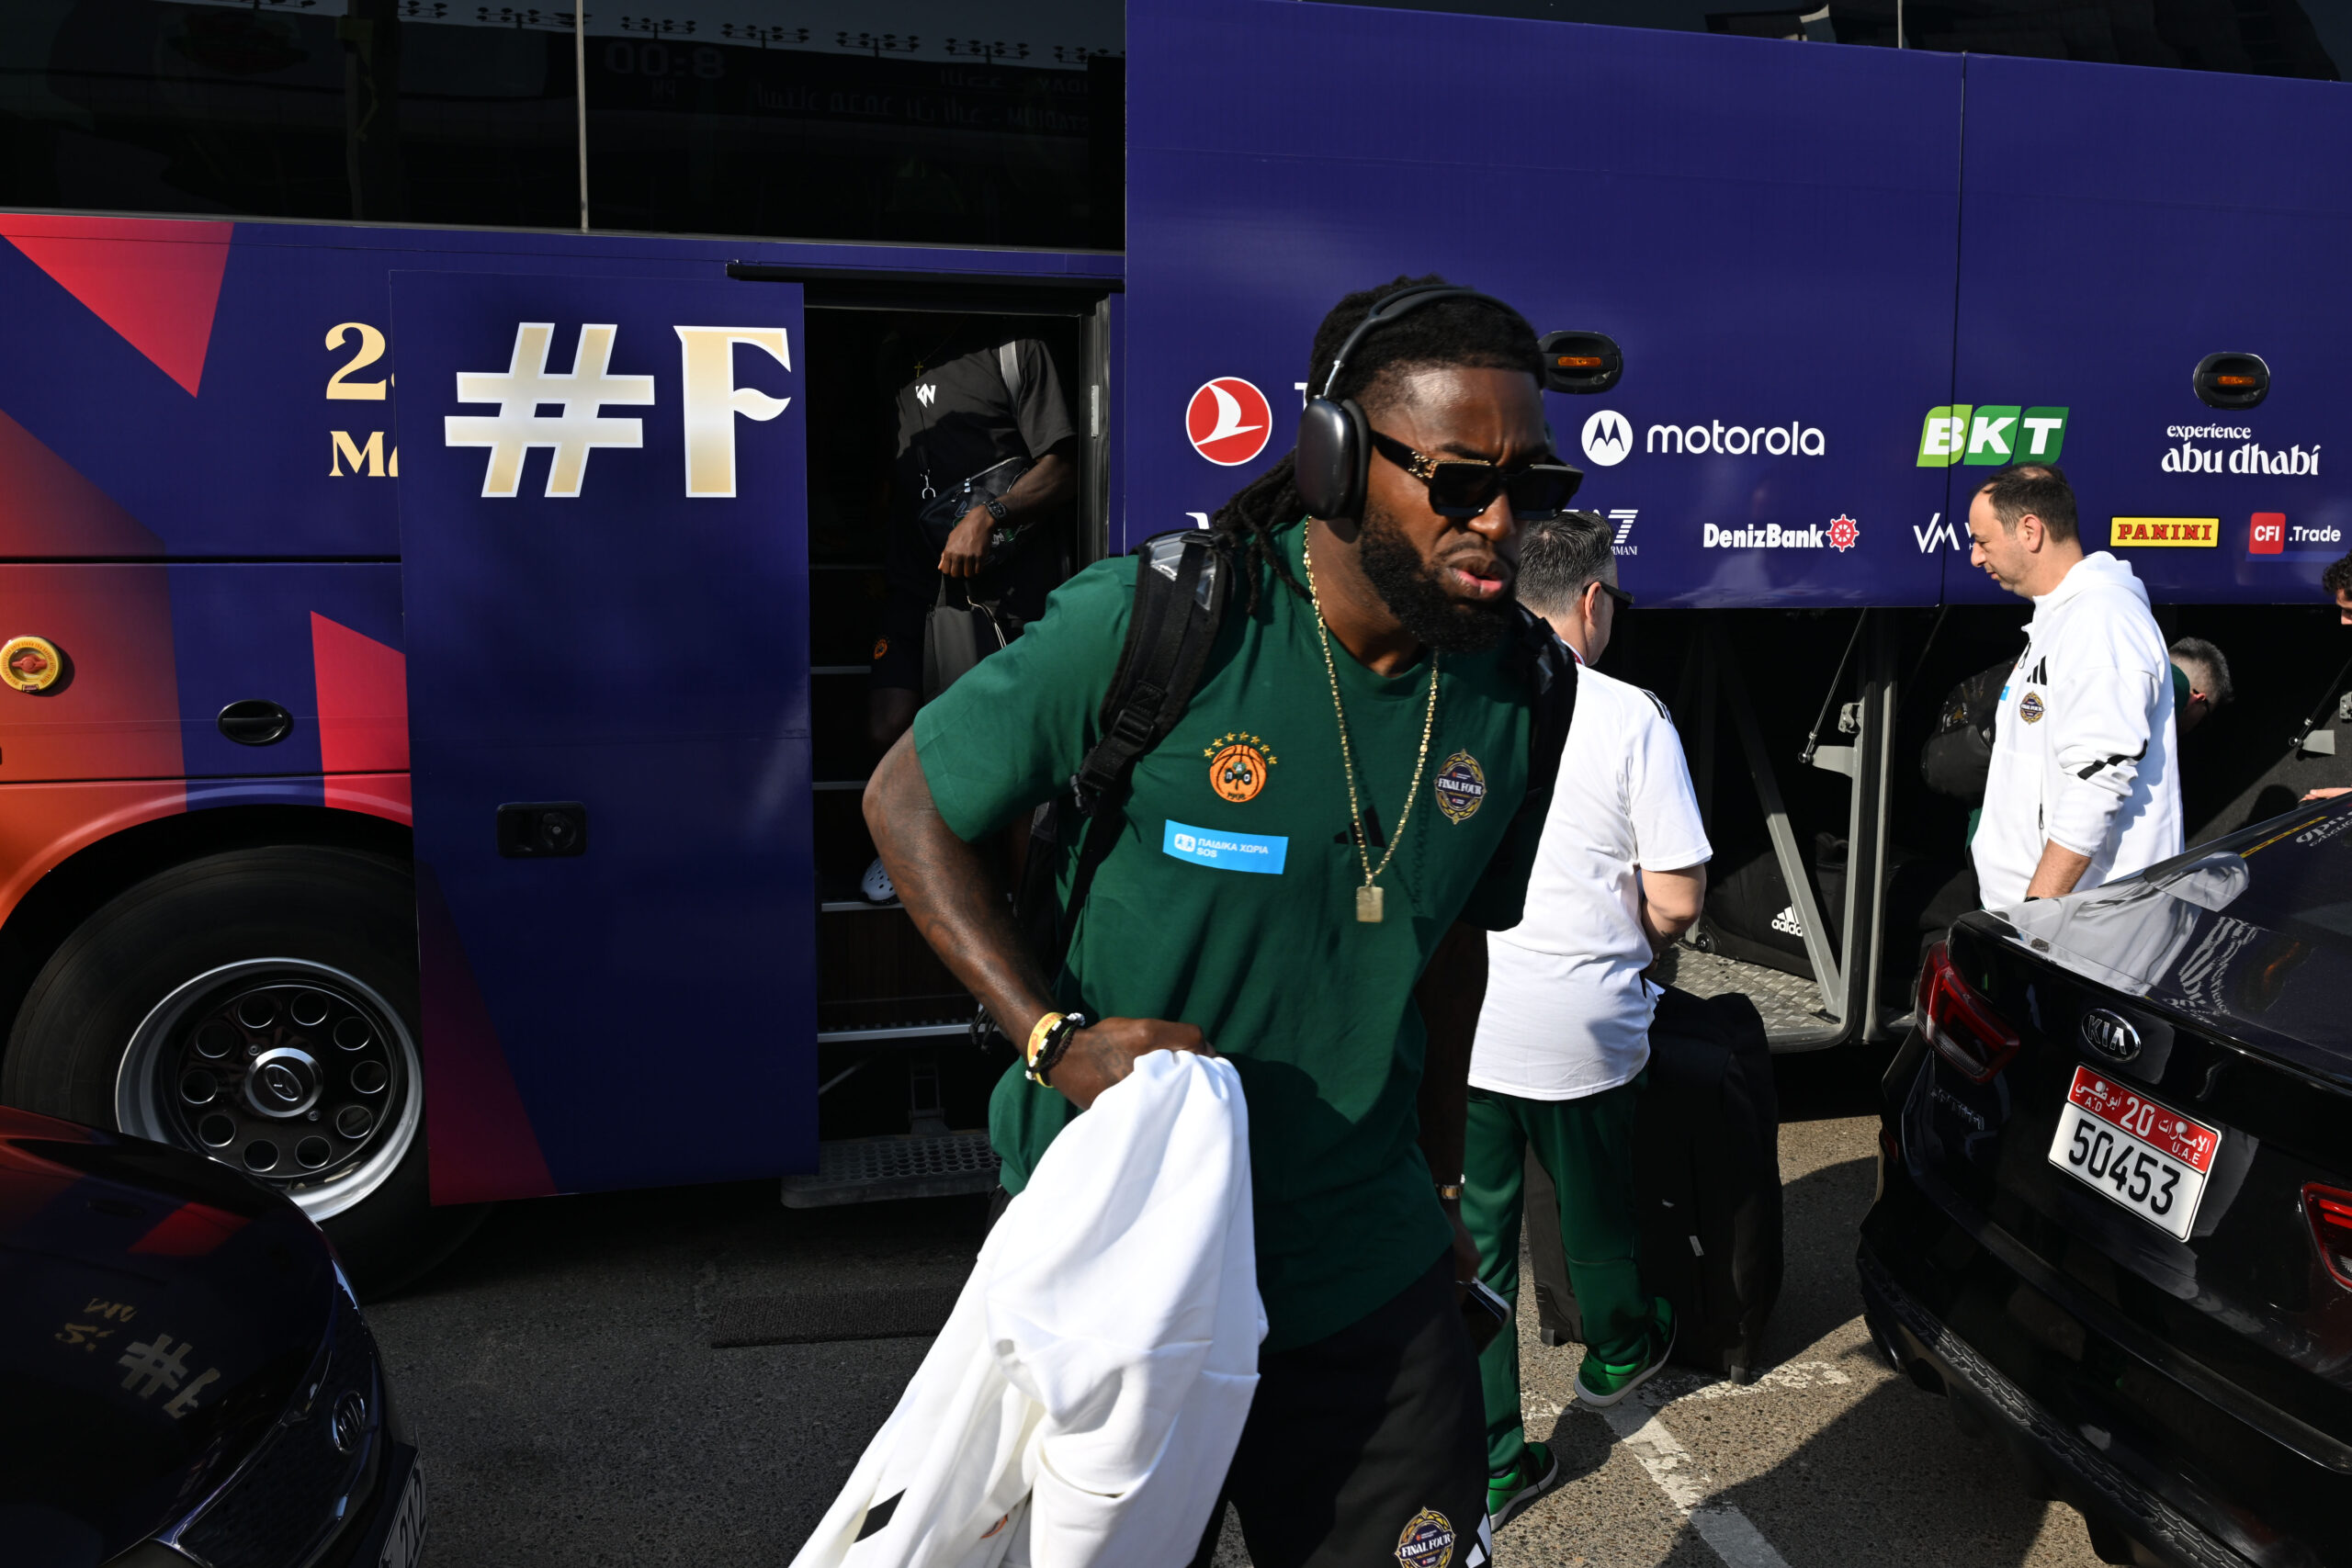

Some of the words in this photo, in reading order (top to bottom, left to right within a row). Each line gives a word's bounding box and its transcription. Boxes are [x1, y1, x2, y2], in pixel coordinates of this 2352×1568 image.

[1647, 419, 1826, 457] motorola
[1923, 416, 2063, 456] BKT
[2161, 441, 2223, 473] abu
[2229, 443, 2322, 476] dhabi
[1703, 523, 1825, 548] DenizBank
[2117, 525, 2212, 541] PANINI
[2254, 525, 2280, 542] CFI
[2289, 525, 2342, 543] .Trade
[1438, 778, 1460, 792] FINAL
[1461, 783, 1482, 795] FOUR
[1196, 848, 1217, 858] SOS
[1198, 839, 1238, 852] ΠΑΙΔΙΚΑ
[1239, 844, 1269, 854] ΧΩΡΙΑ
[2086, 1014, 2128, 1055] KIA
[2120, 1096, 2155, 1137] 20
[2171, 1141, 2201, 1166] U.A.E
[2068, 1118, 2182, 1216] 50453
[1401, 1544, 1428, 1558] FINAL
[1429, 1533, 1451, 1550] FOUR
